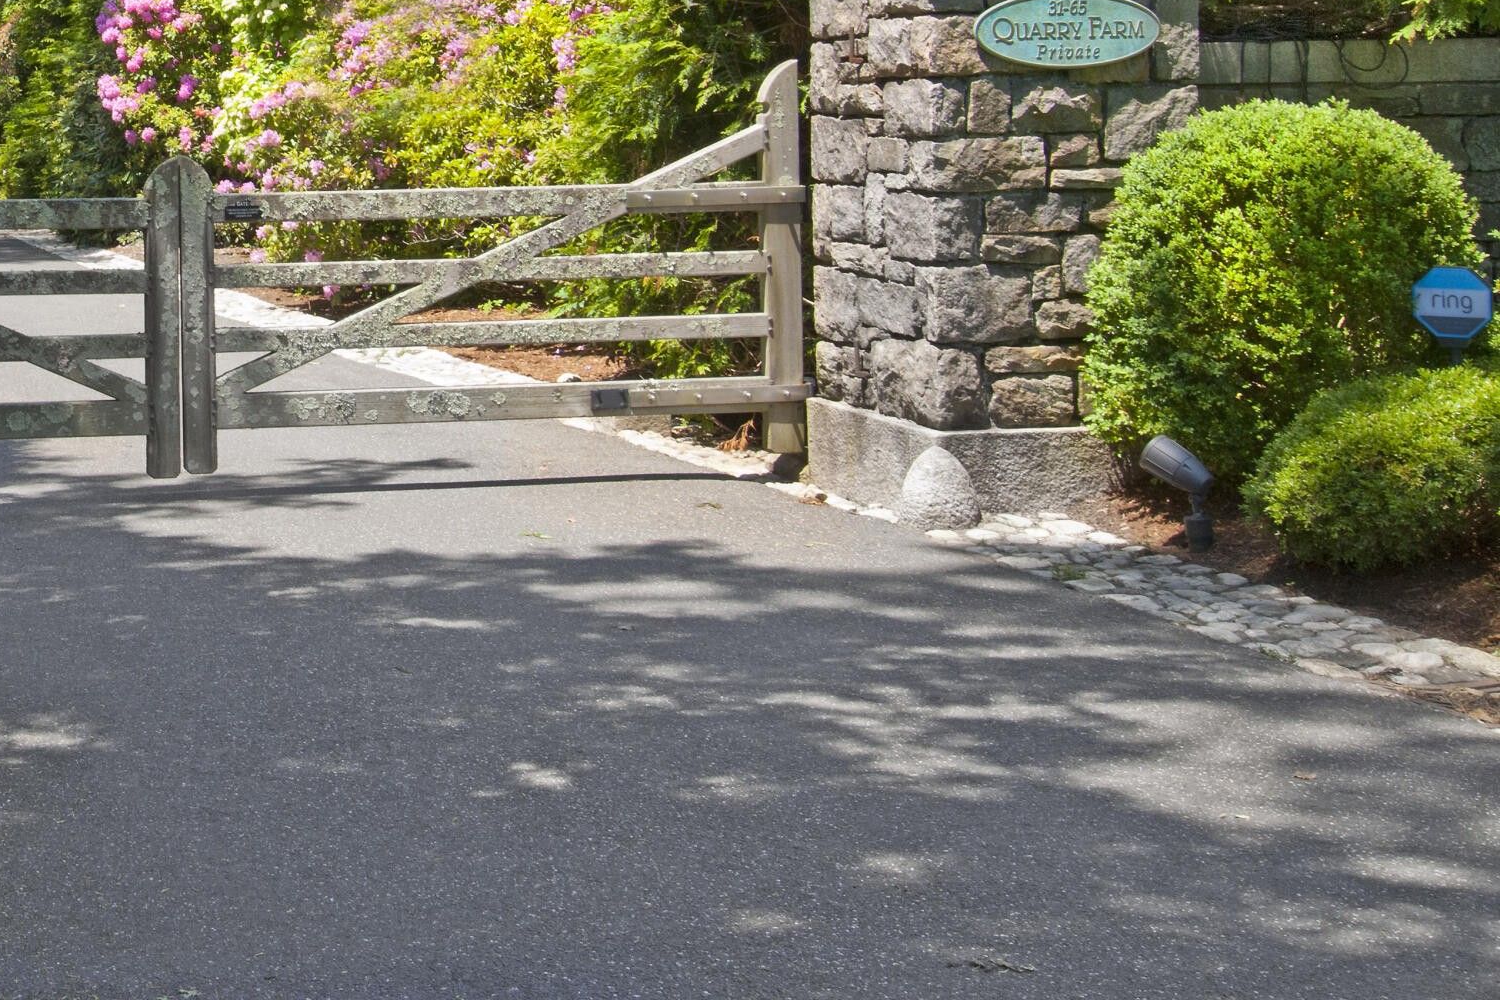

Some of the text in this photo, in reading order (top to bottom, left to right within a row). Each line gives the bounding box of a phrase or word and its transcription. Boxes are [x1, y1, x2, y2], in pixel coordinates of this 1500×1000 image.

[1048, 0, 1088, 16] 31-65
[992, 17, 1145, 45] QUARRY FARM
[1036, 44, 1101, 60] Private
[1431, 290, 1473, 314] ring
